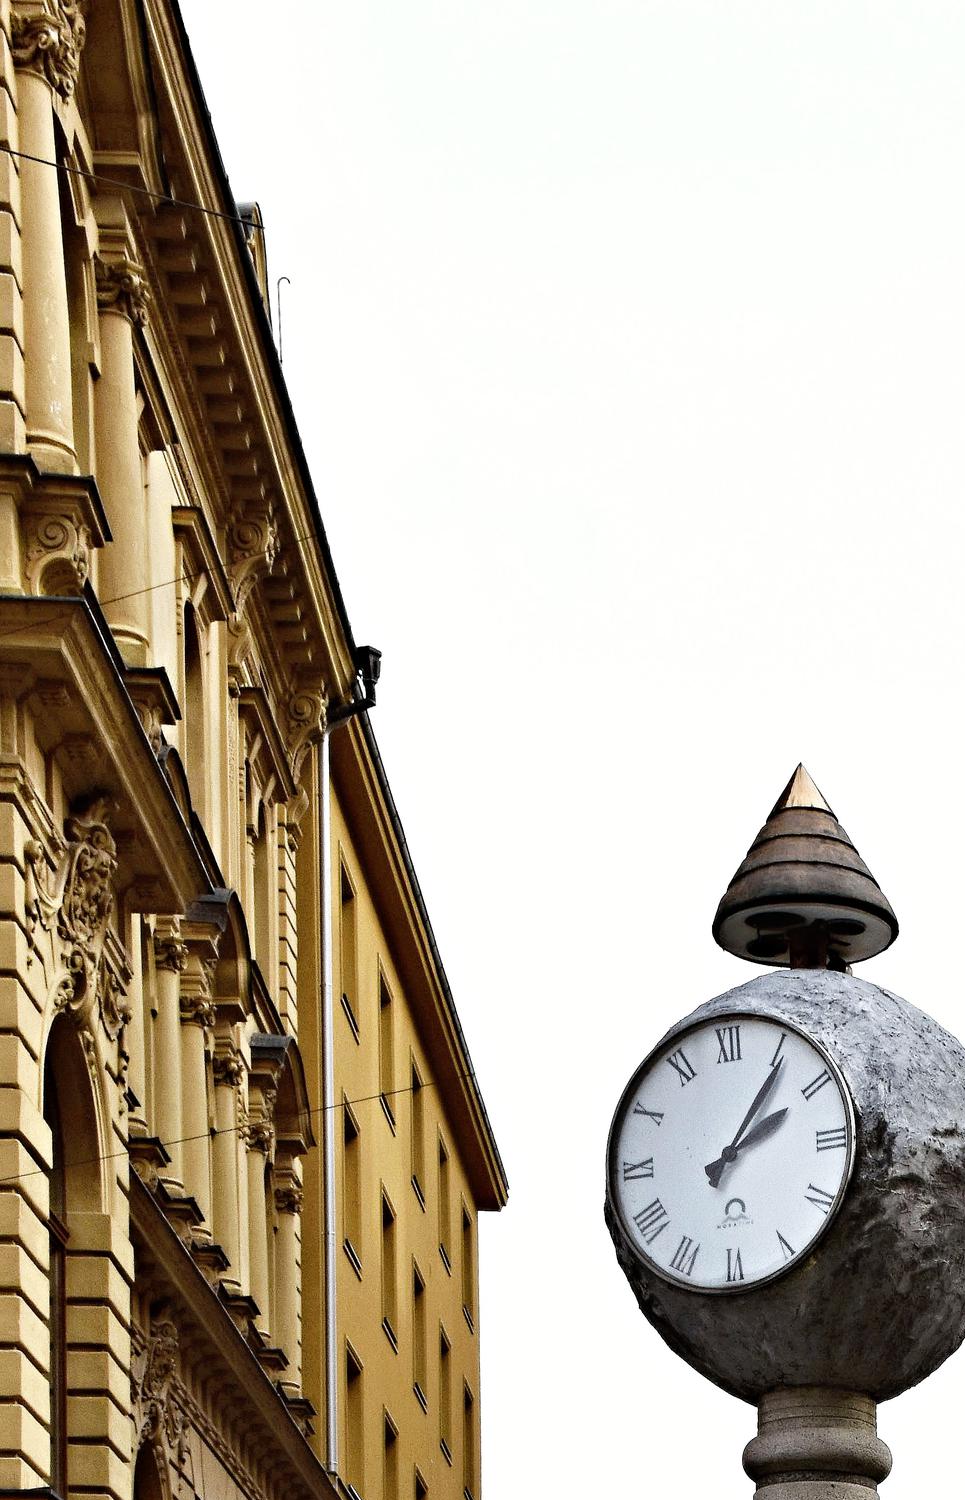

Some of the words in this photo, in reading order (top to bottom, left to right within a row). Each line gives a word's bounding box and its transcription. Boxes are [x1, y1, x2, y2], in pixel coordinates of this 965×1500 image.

[714, 1025, 743, 1064] XII
[769, 1033, 787, 1067] I
[666, 1048, 697, 1087] XI
[801, 1068, 832, 1101] II
[633, 1102, 664, 1126] X
[815, 1126, 847, 1152] III
[623, 1157, 654, 1182] IX
[804, 1183, 835, 1215] IV
[633, 1197, 671, 1245] VIII
[669, 1235, 700, 1277] VII
[776, 1229, 796, 1261] V
[726, 1247, 744, 1282] VI
